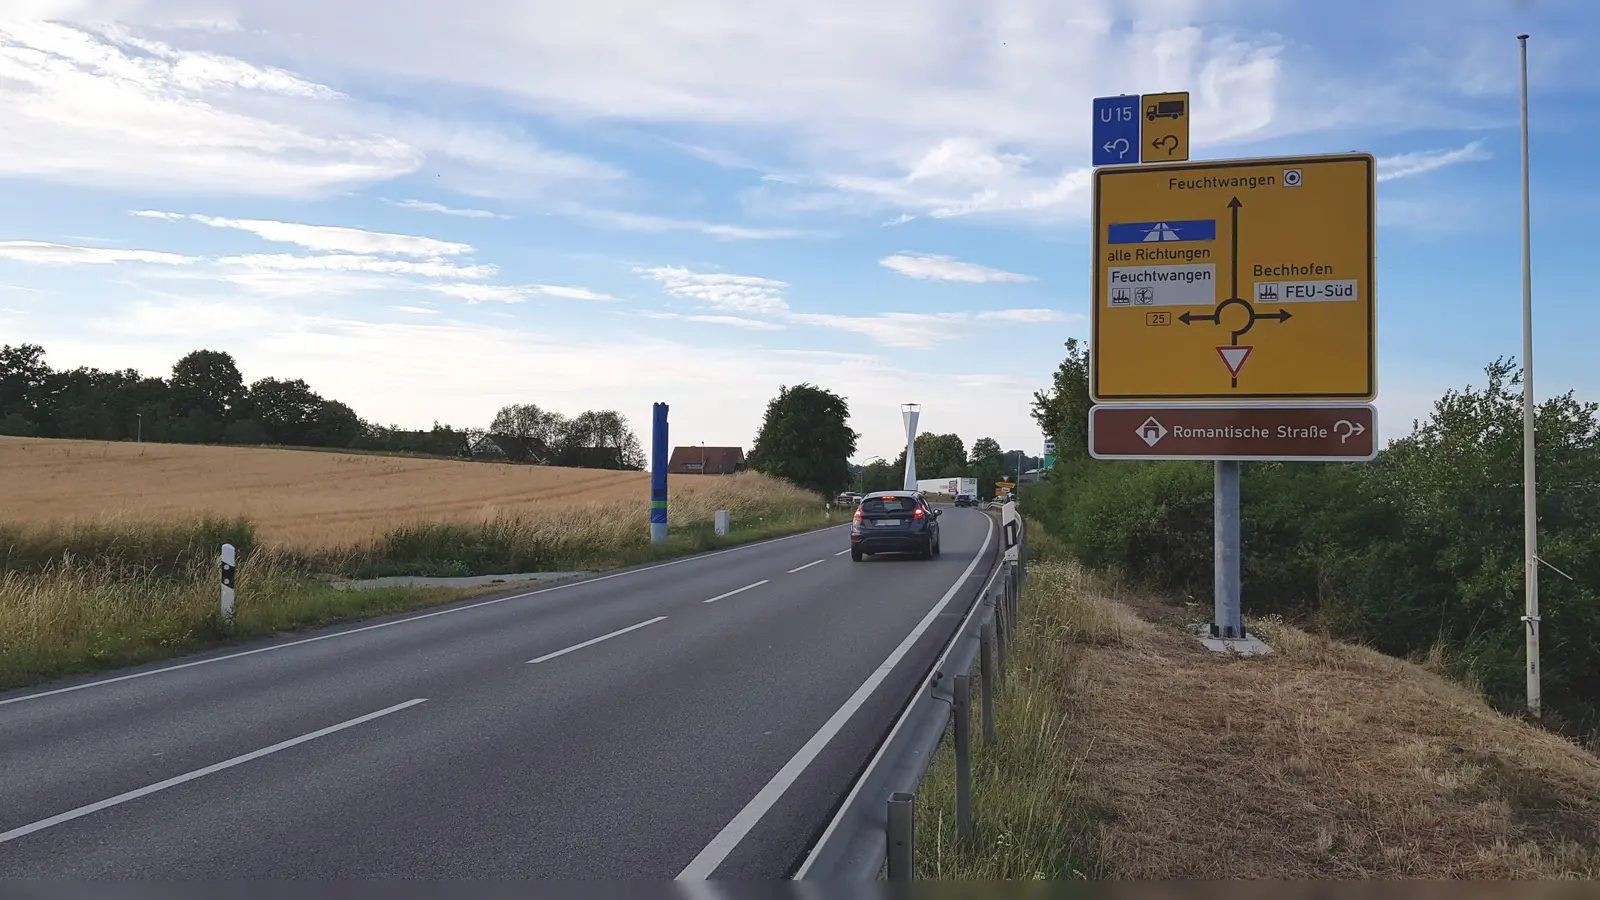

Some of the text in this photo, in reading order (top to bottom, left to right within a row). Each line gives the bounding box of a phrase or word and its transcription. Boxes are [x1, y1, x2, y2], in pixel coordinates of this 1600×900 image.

[1101, 106, 1132, 122] U 15
[1169, 174, 1275, 192] Feuchtwangen
[1107, 248, 1211, 263] alle Richtungen
[1112, 270, 1211, 284] Feuchtwangen
[1253, 264, 1333, 277] Bechhofen
[1286, 284, 1353, 298] FEU-Süd
[1152, 314, 1165, 324] 25
[1173, 426, 1327, 438] Romantische Straße
